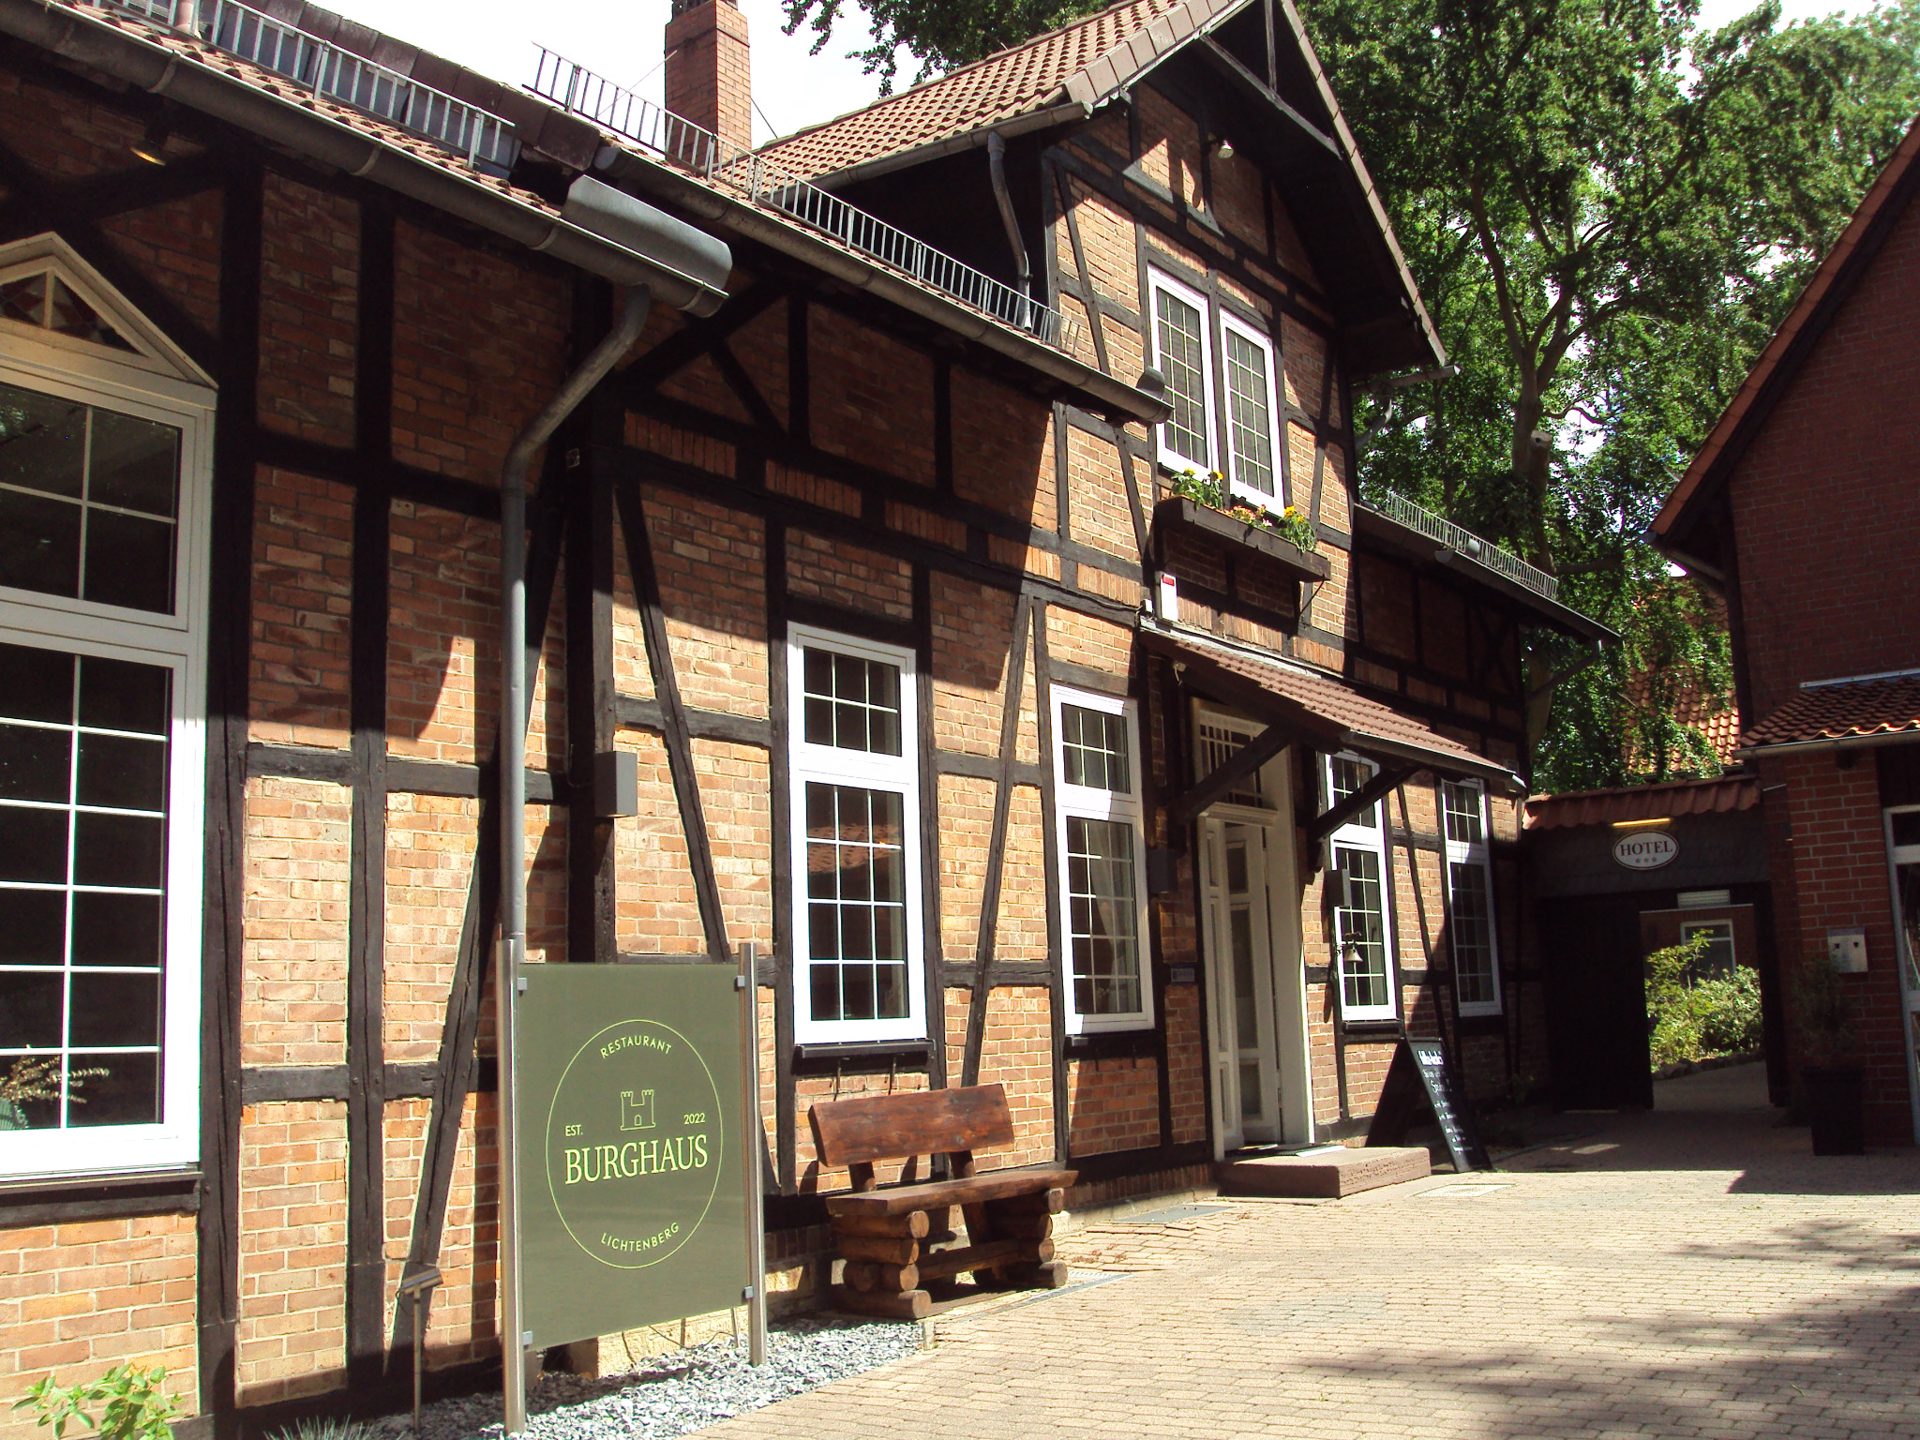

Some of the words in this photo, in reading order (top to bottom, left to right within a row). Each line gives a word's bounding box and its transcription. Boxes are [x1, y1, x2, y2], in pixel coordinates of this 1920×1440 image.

[1620, 840, 1673, 856] HOTEL
[600, 1035, 672, 1059] RESTAURANT
[565, 1124, 583, 1137] EST.
[683, 1112, 705, 1125] 2022
[564, 1134, 708, 1185] BURGHAUS
[601, 1221, 680, 1252] LICHTENBERG
